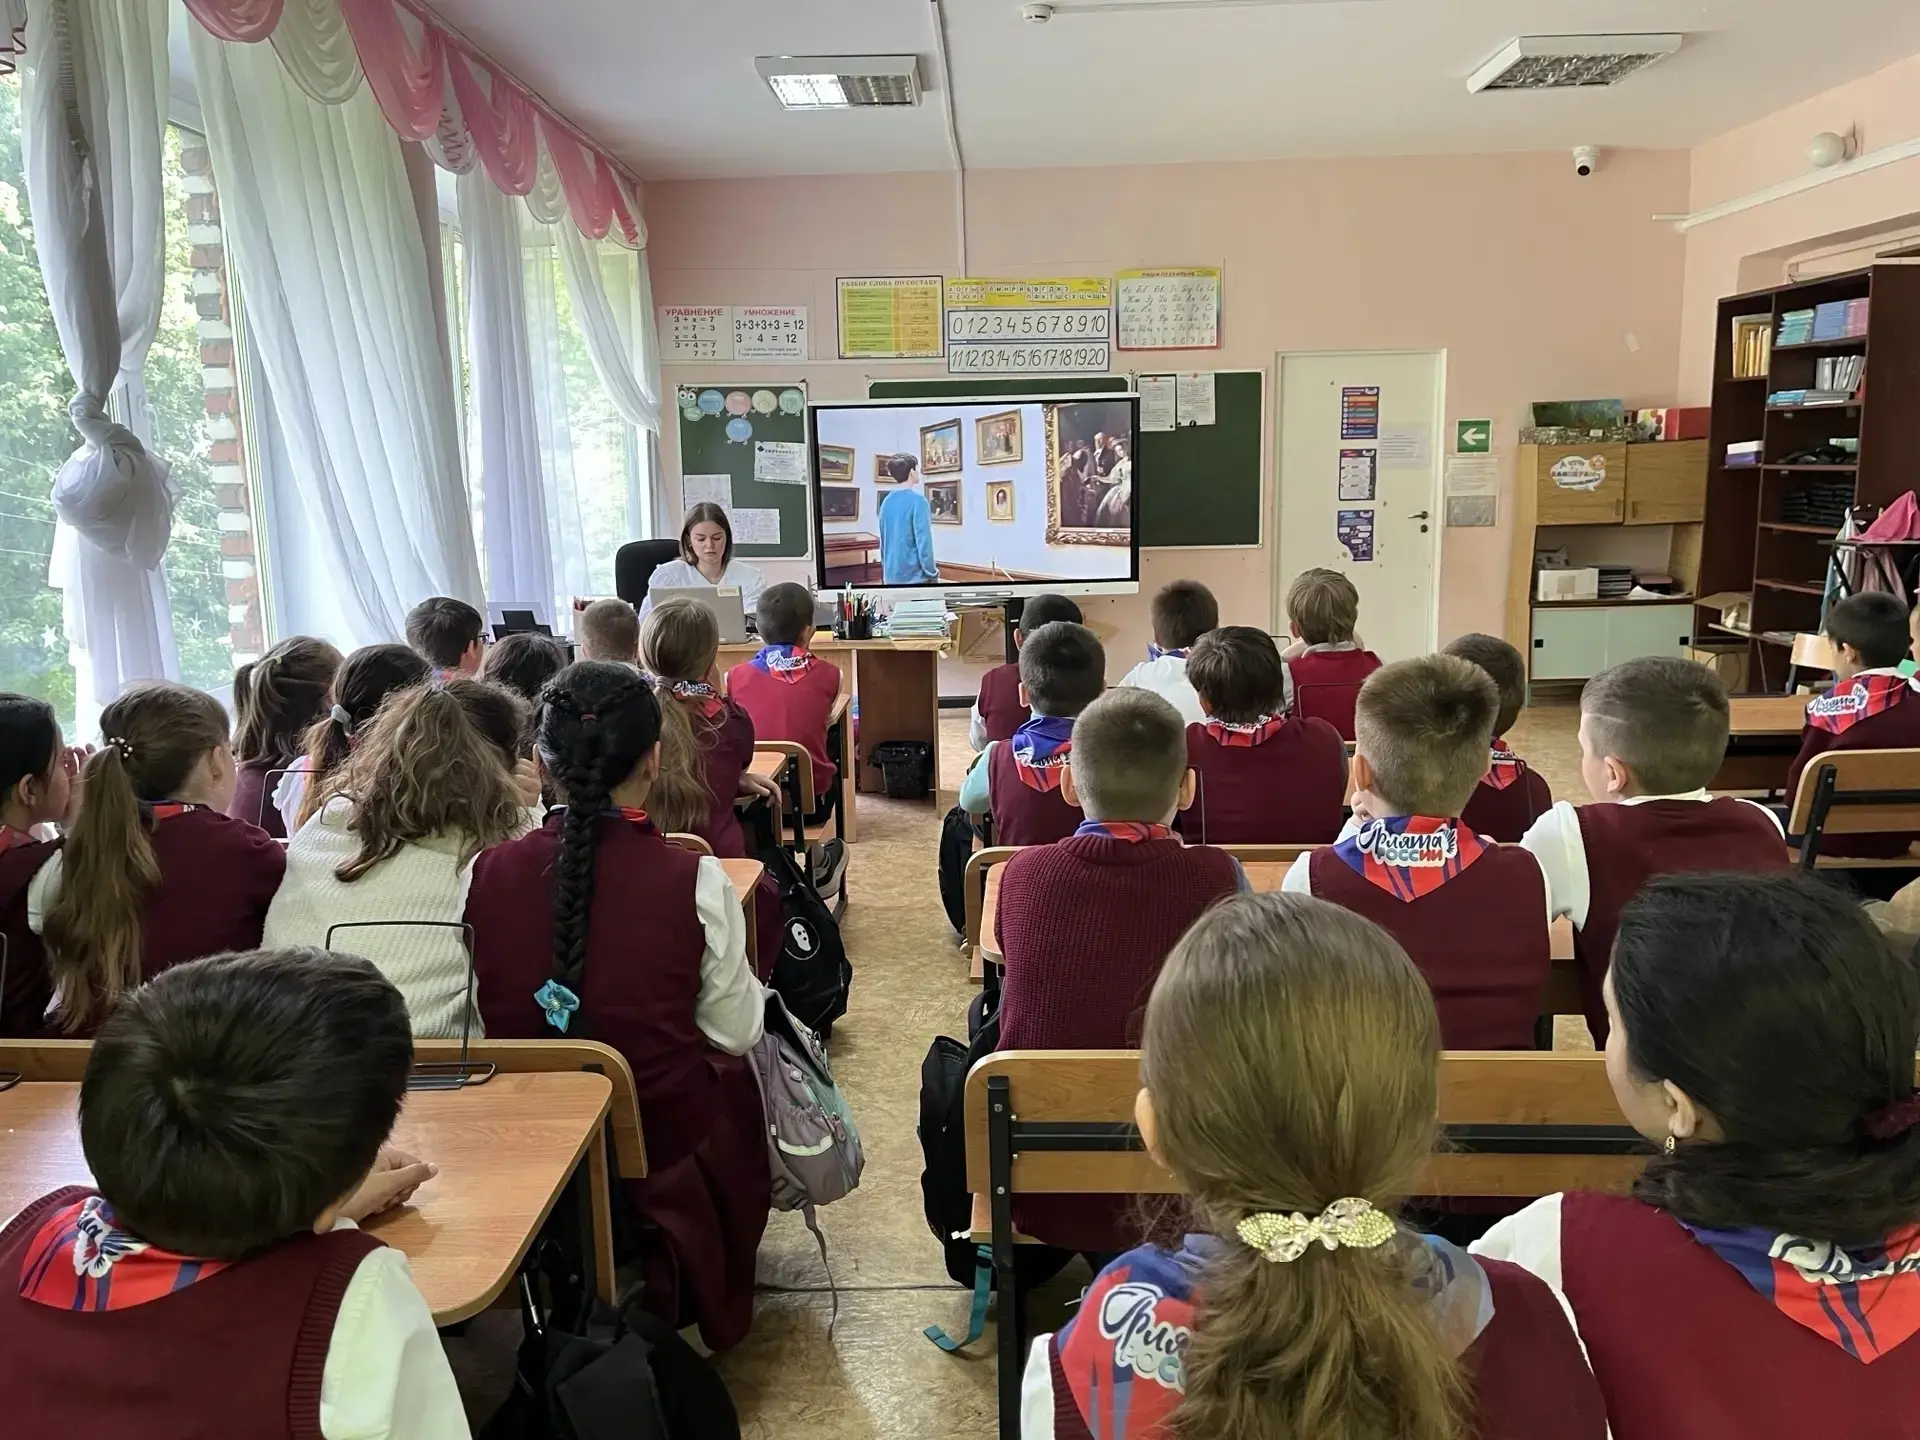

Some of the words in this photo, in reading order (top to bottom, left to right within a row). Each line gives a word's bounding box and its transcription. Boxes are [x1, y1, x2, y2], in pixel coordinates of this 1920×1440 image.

[736, 320, 780, 330] 3+3+3+3
[794, 320, 804, 330] 12
[953, 318, 963, 334] 0
[968, 318, 974, 334] 1
[978, 317, 987, 334] 2
[993, 317, 1002, 334] 3
[1007, 317, 1016, 333] 4
[1022, 317, 1032, 333] 5
[1037, 316, 1047, 333] 6
[1050, 316, 1060, 332] 7
[1064, 316, 1073, 332] 8
[1077, 316, 1087, 332] 9
[1091, 315, 1105, 332] 10
[736, 334, 742, 343] 3
[757, 334, 763, 343] 4
[786, 334, 796, 343] 12
[952, 350, 962, 367] 11
[965, 350, 979, 367] 12
[981, 350, 994, 366] 13
[996, 350, 1010, 366] 14
[1012, 350, 1026, 366] 15
[1028, 350, 1041, 366] 16
[1044, 349, 1058, 366] 17
[1059, 349, 1072, 366] 18
[1074, 349, 1087, 366] 19
[1088, 349, 1105, 365] 20
[1359, 822, 1442, 854] Орлята
